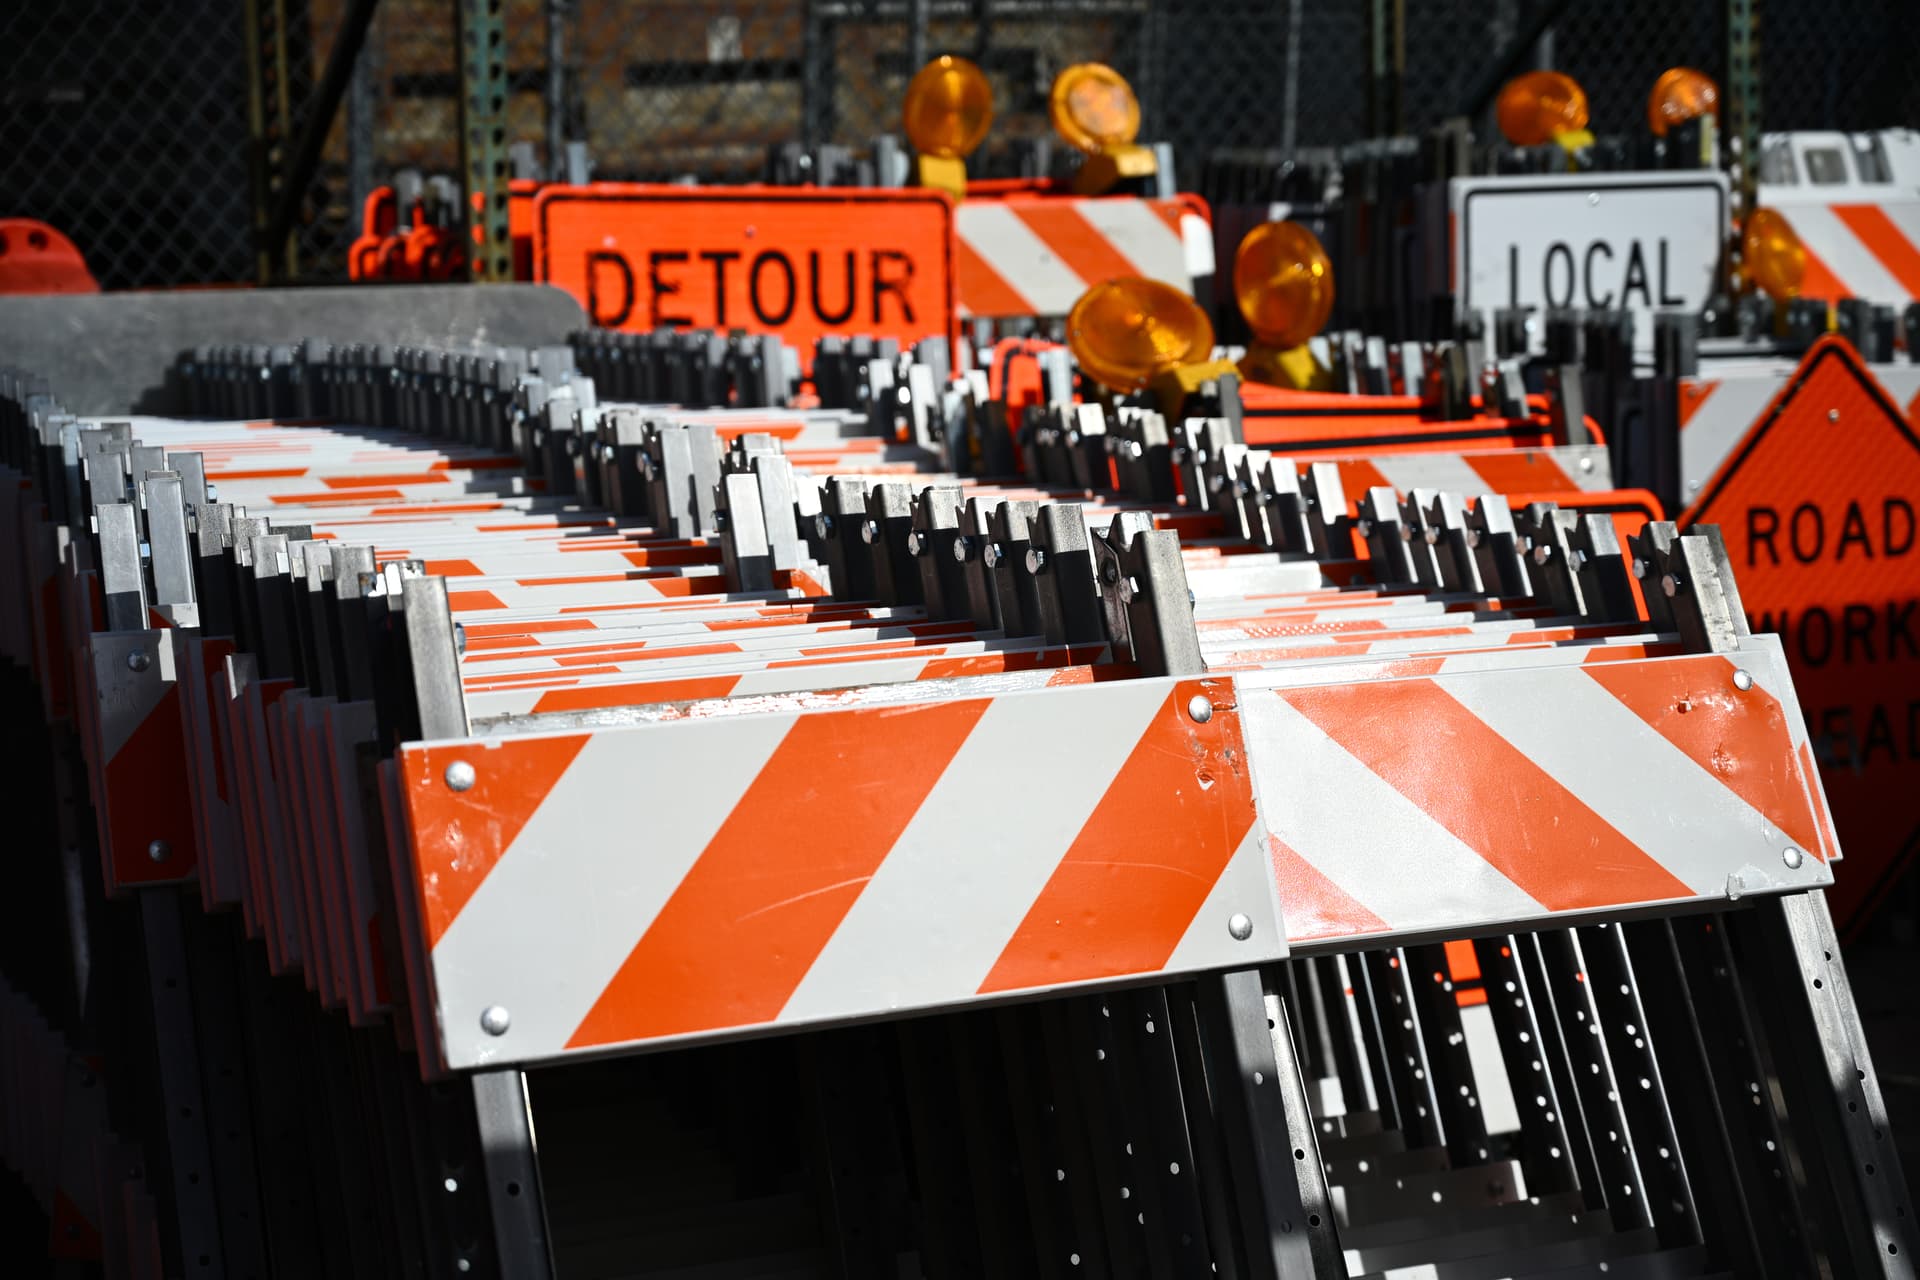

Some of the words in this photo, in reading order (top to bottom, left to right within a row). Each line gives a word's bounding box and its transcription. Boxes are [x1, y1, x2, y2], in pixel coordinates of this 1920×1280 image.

[588, 250, 915, 327] DETOUR
[1509, 238, 1685, 310] LOCAL
[1747, 499, 1916, 567] ROAD
